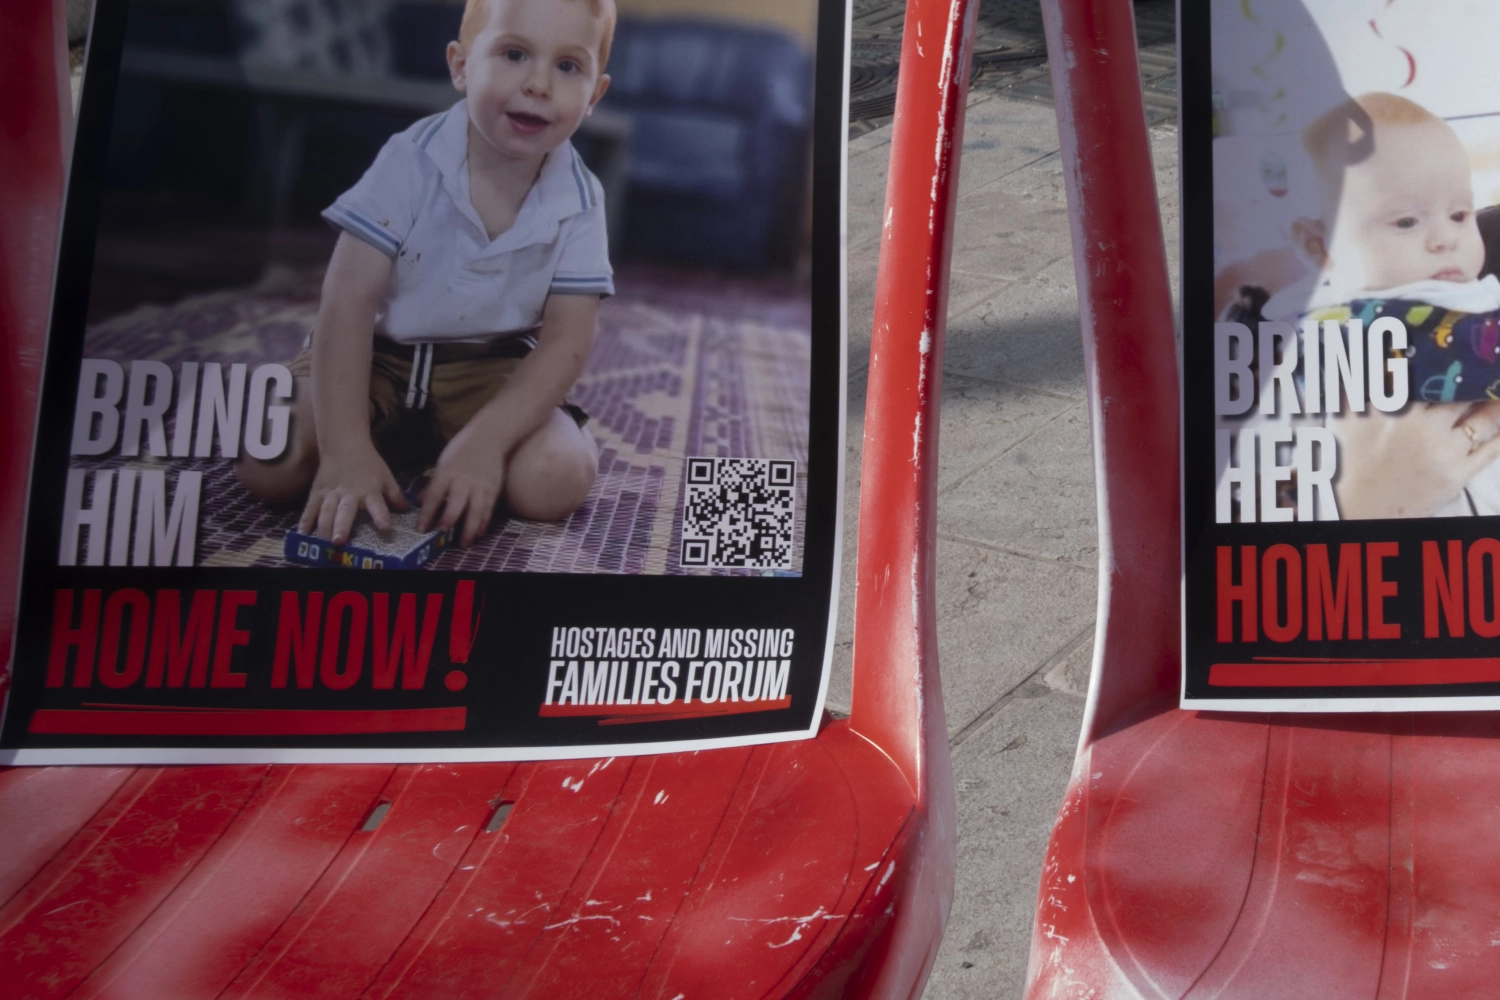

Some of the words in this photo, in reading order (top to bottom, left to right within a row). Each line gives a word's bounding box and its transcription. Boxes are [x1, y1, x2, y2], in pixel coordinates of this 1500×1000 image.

[70, 358, 293, 460] BRING
[1214, 316, 1409, 415] BRING
[58, 468, 202, 567] HIM
[1215, 426, 1340, 524] HER
[45, 588, 258, 689] HOME
[270, 580, 480, 692] NOW!
[1216, 541, 1401, 643] HOME
[545, 660, 680, 705] FAMILIES
[684, 660, 791, 704] FORUM
[551, 627, 656, 658] HOSTAGES
[658, 628, 700, 658] AND
[704, 628, 794, 658] MISSING
